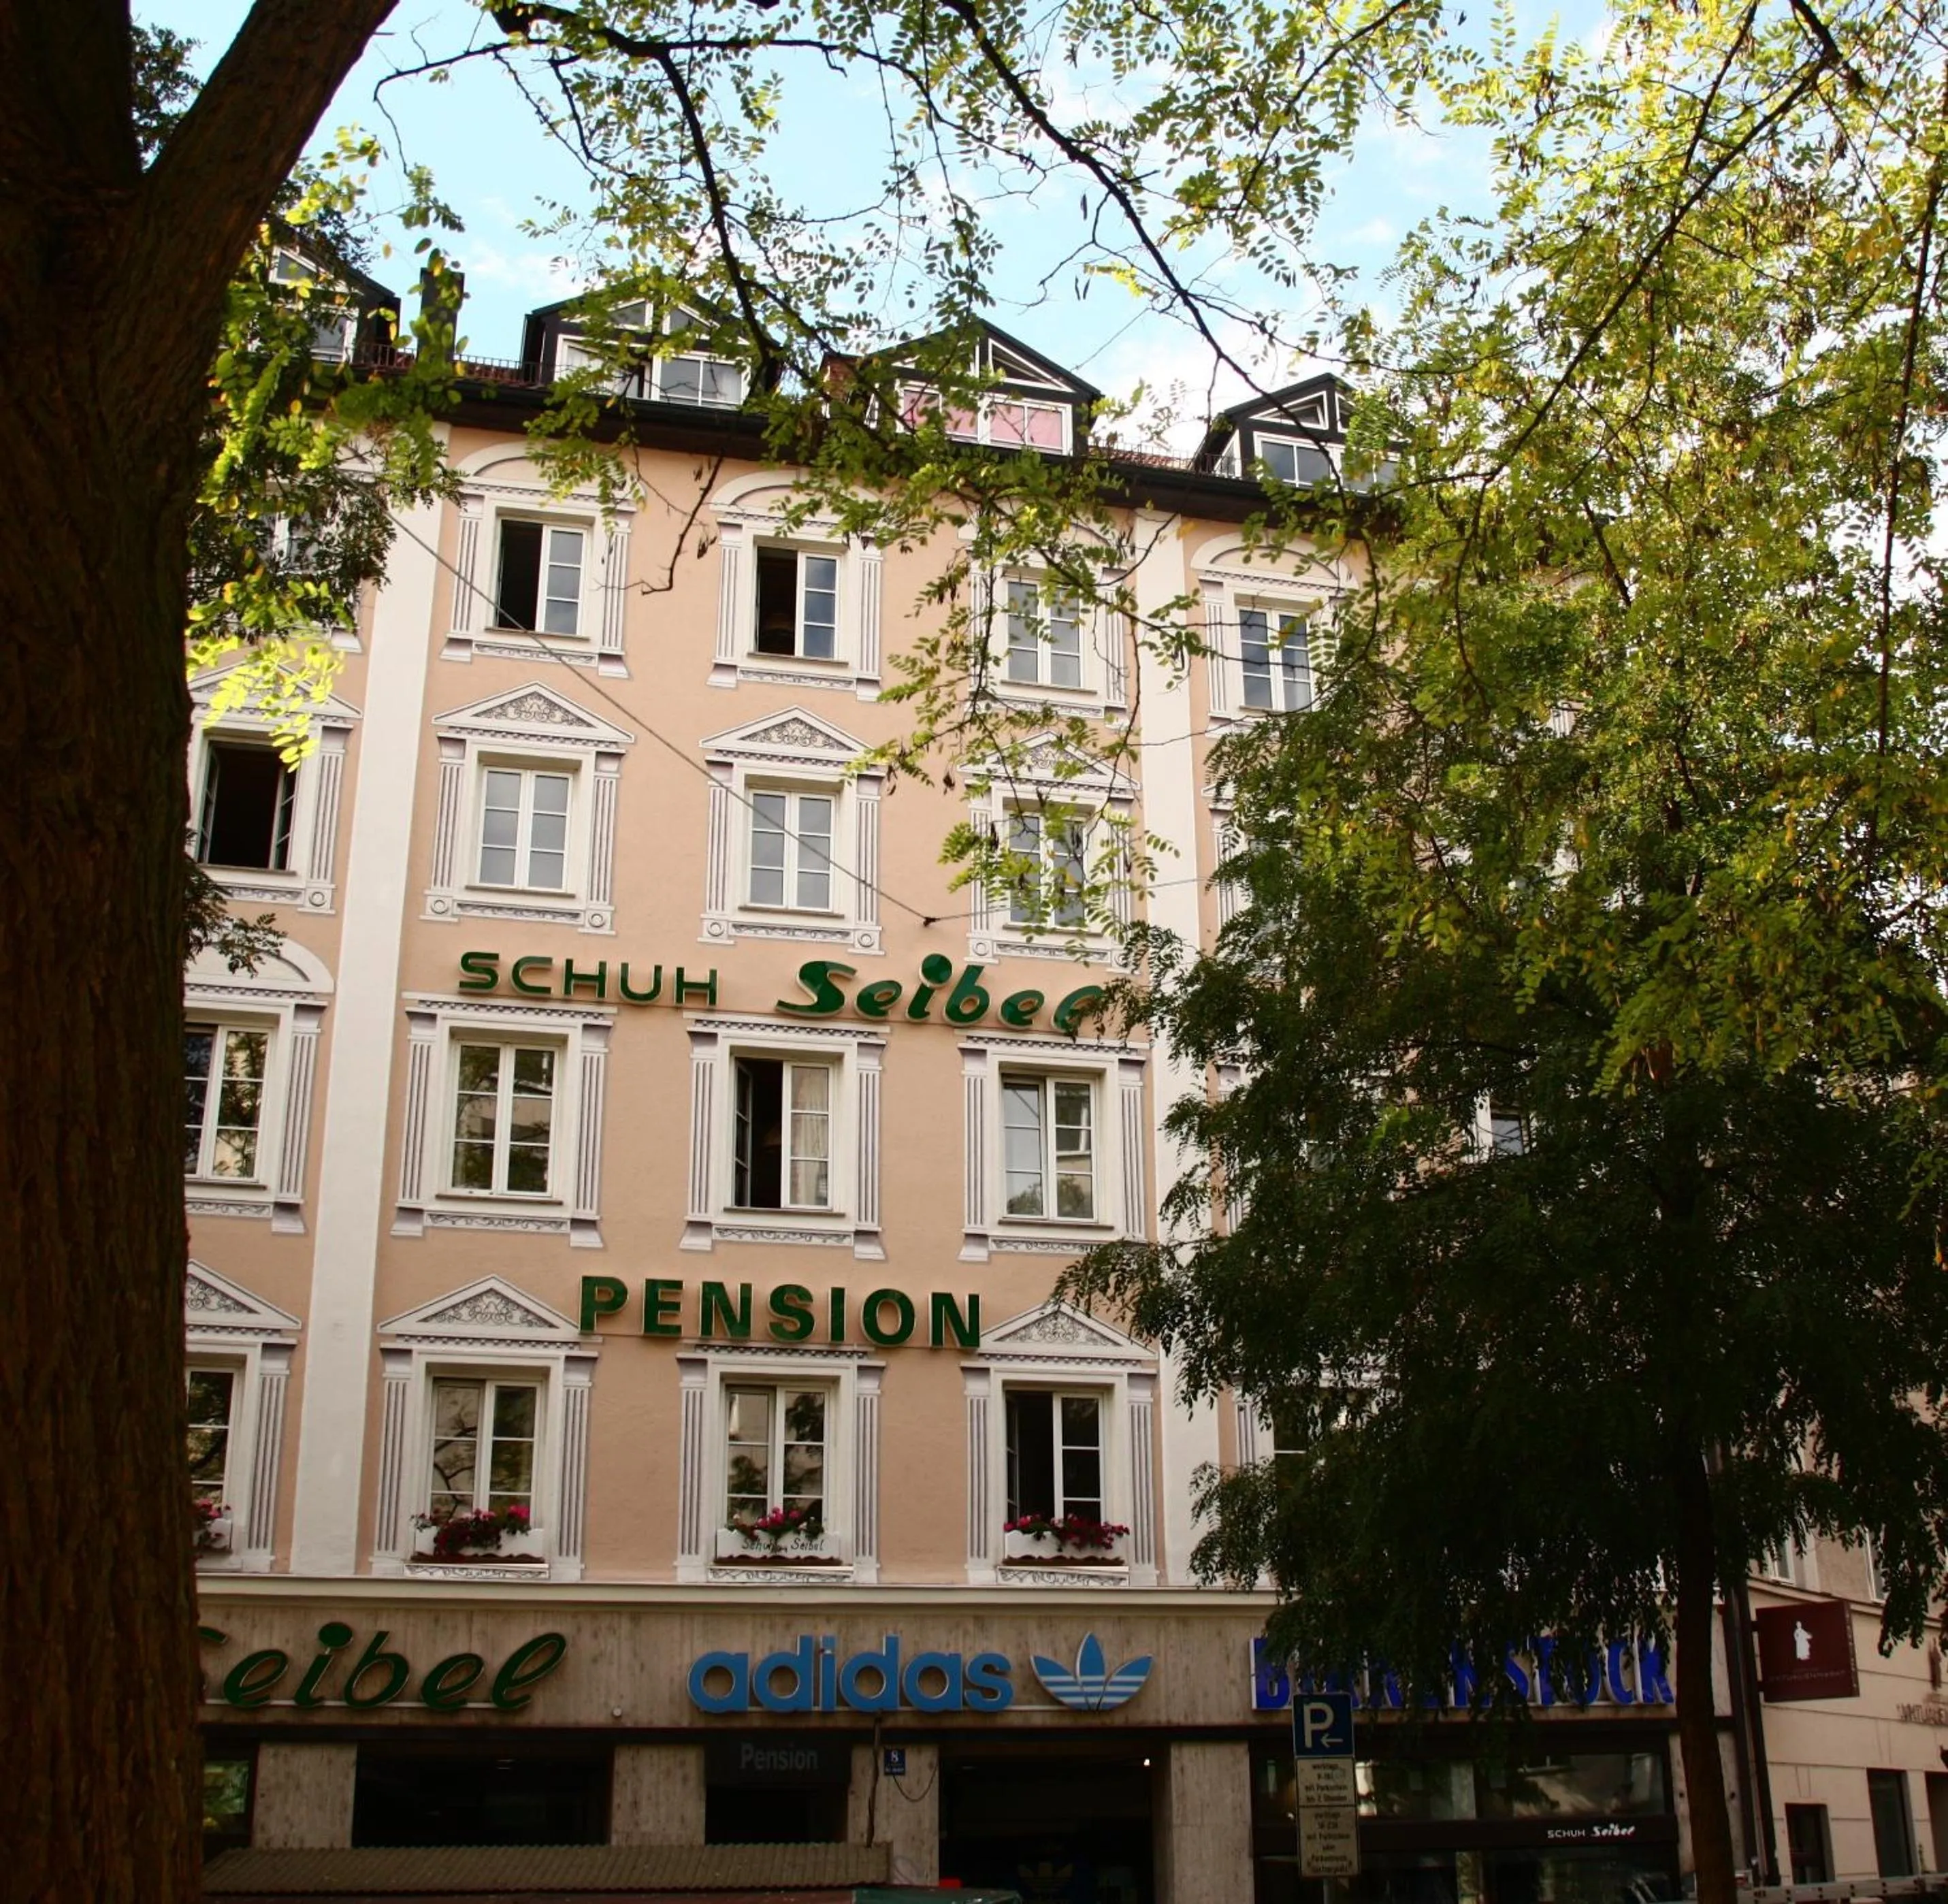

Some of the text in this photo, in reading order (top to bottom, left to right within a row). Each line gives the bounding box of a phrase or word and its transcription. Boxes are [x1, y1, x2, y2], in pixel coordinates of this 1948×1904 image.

[459, 951, 1104, 1033] SCHUH Seibel
[579, 1275, 981, 1349] PENSION
[197, 1621, 567, 1711] eibel
[687, 1634, 1014, 1713] adidas
[1303, 1702, 1334, 1749] P
[739, 1741, 819, 1771] Pension
[890, 1749, 899, 1763] 8
[1546, 1822, 1636, 1839] SCHUH Seibel
